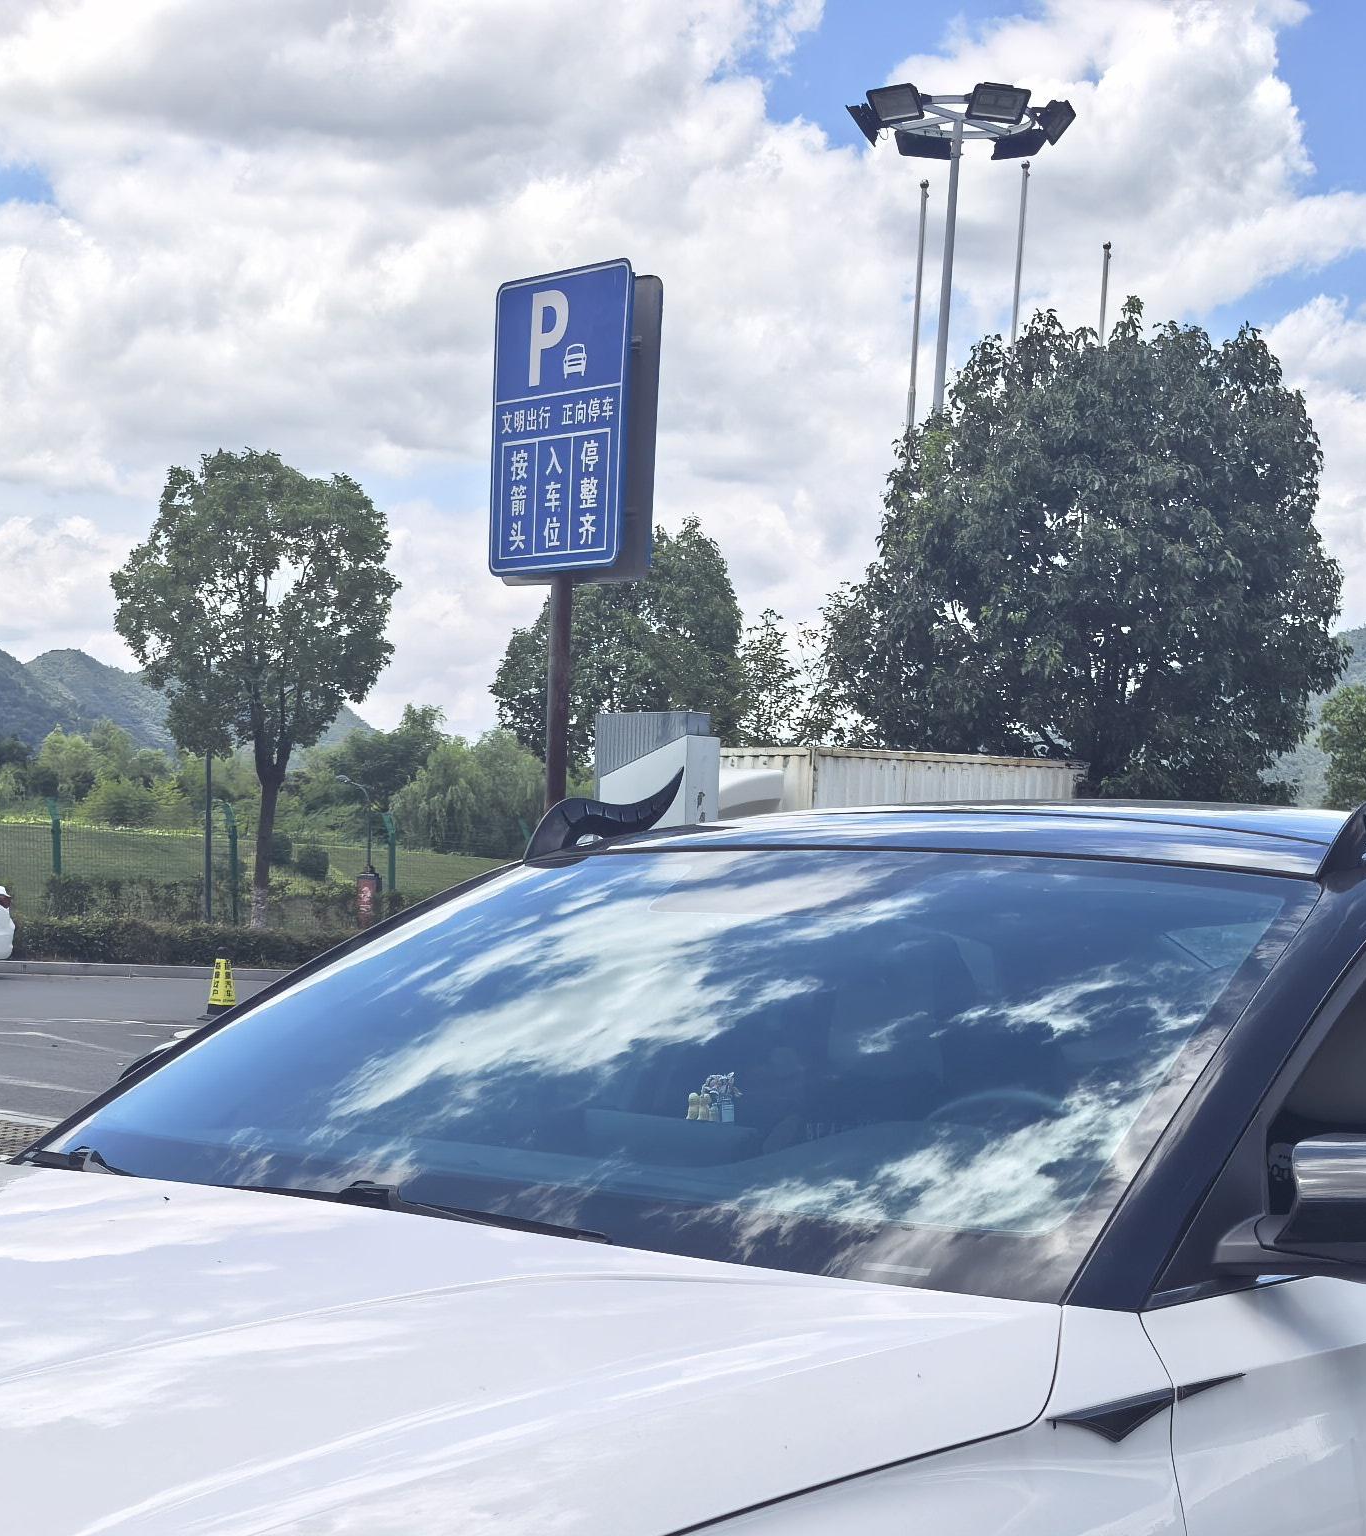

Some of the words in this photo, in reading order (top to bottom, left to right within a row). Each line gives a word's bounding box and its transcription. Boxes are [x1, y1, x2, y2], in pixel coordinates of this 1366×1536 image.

[528, 289, 570, 387] P
[501, 406, 551, 434] 文明出行
[561, 396, 614, 425] 正向停车
[508, 450, 528, 551] 按箭头
[543, 446, 563, 549] 入车位
[579, 440, 599, 545] 停整齐
